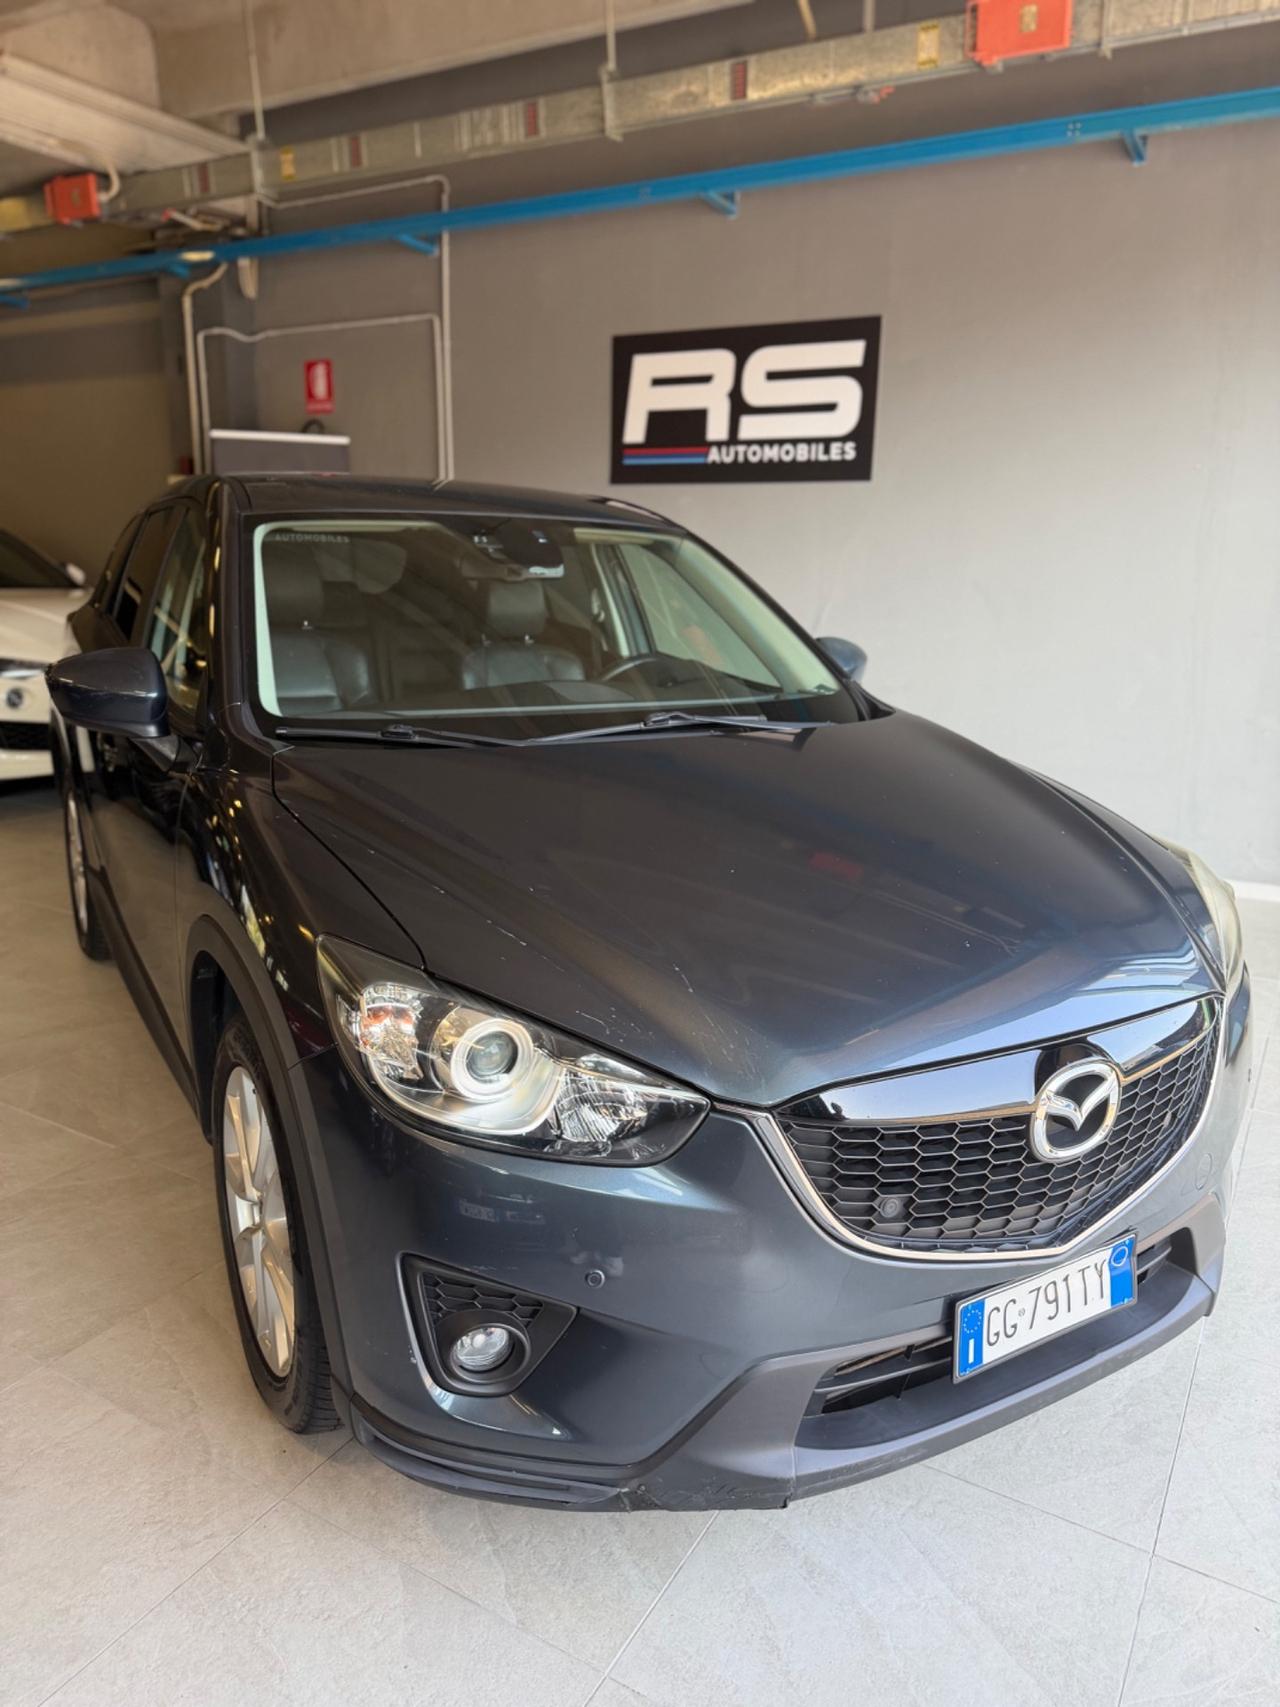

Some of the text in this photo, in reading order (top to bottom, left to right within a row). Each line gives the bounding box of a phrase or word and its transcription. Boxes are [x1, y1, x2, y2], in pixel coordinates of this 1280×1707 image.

[622, 339, 867, 444] RS
[706, 441, 857, 464] AUTOMOBILES
[274, 533, 350, 544] AUTOMOBILES
